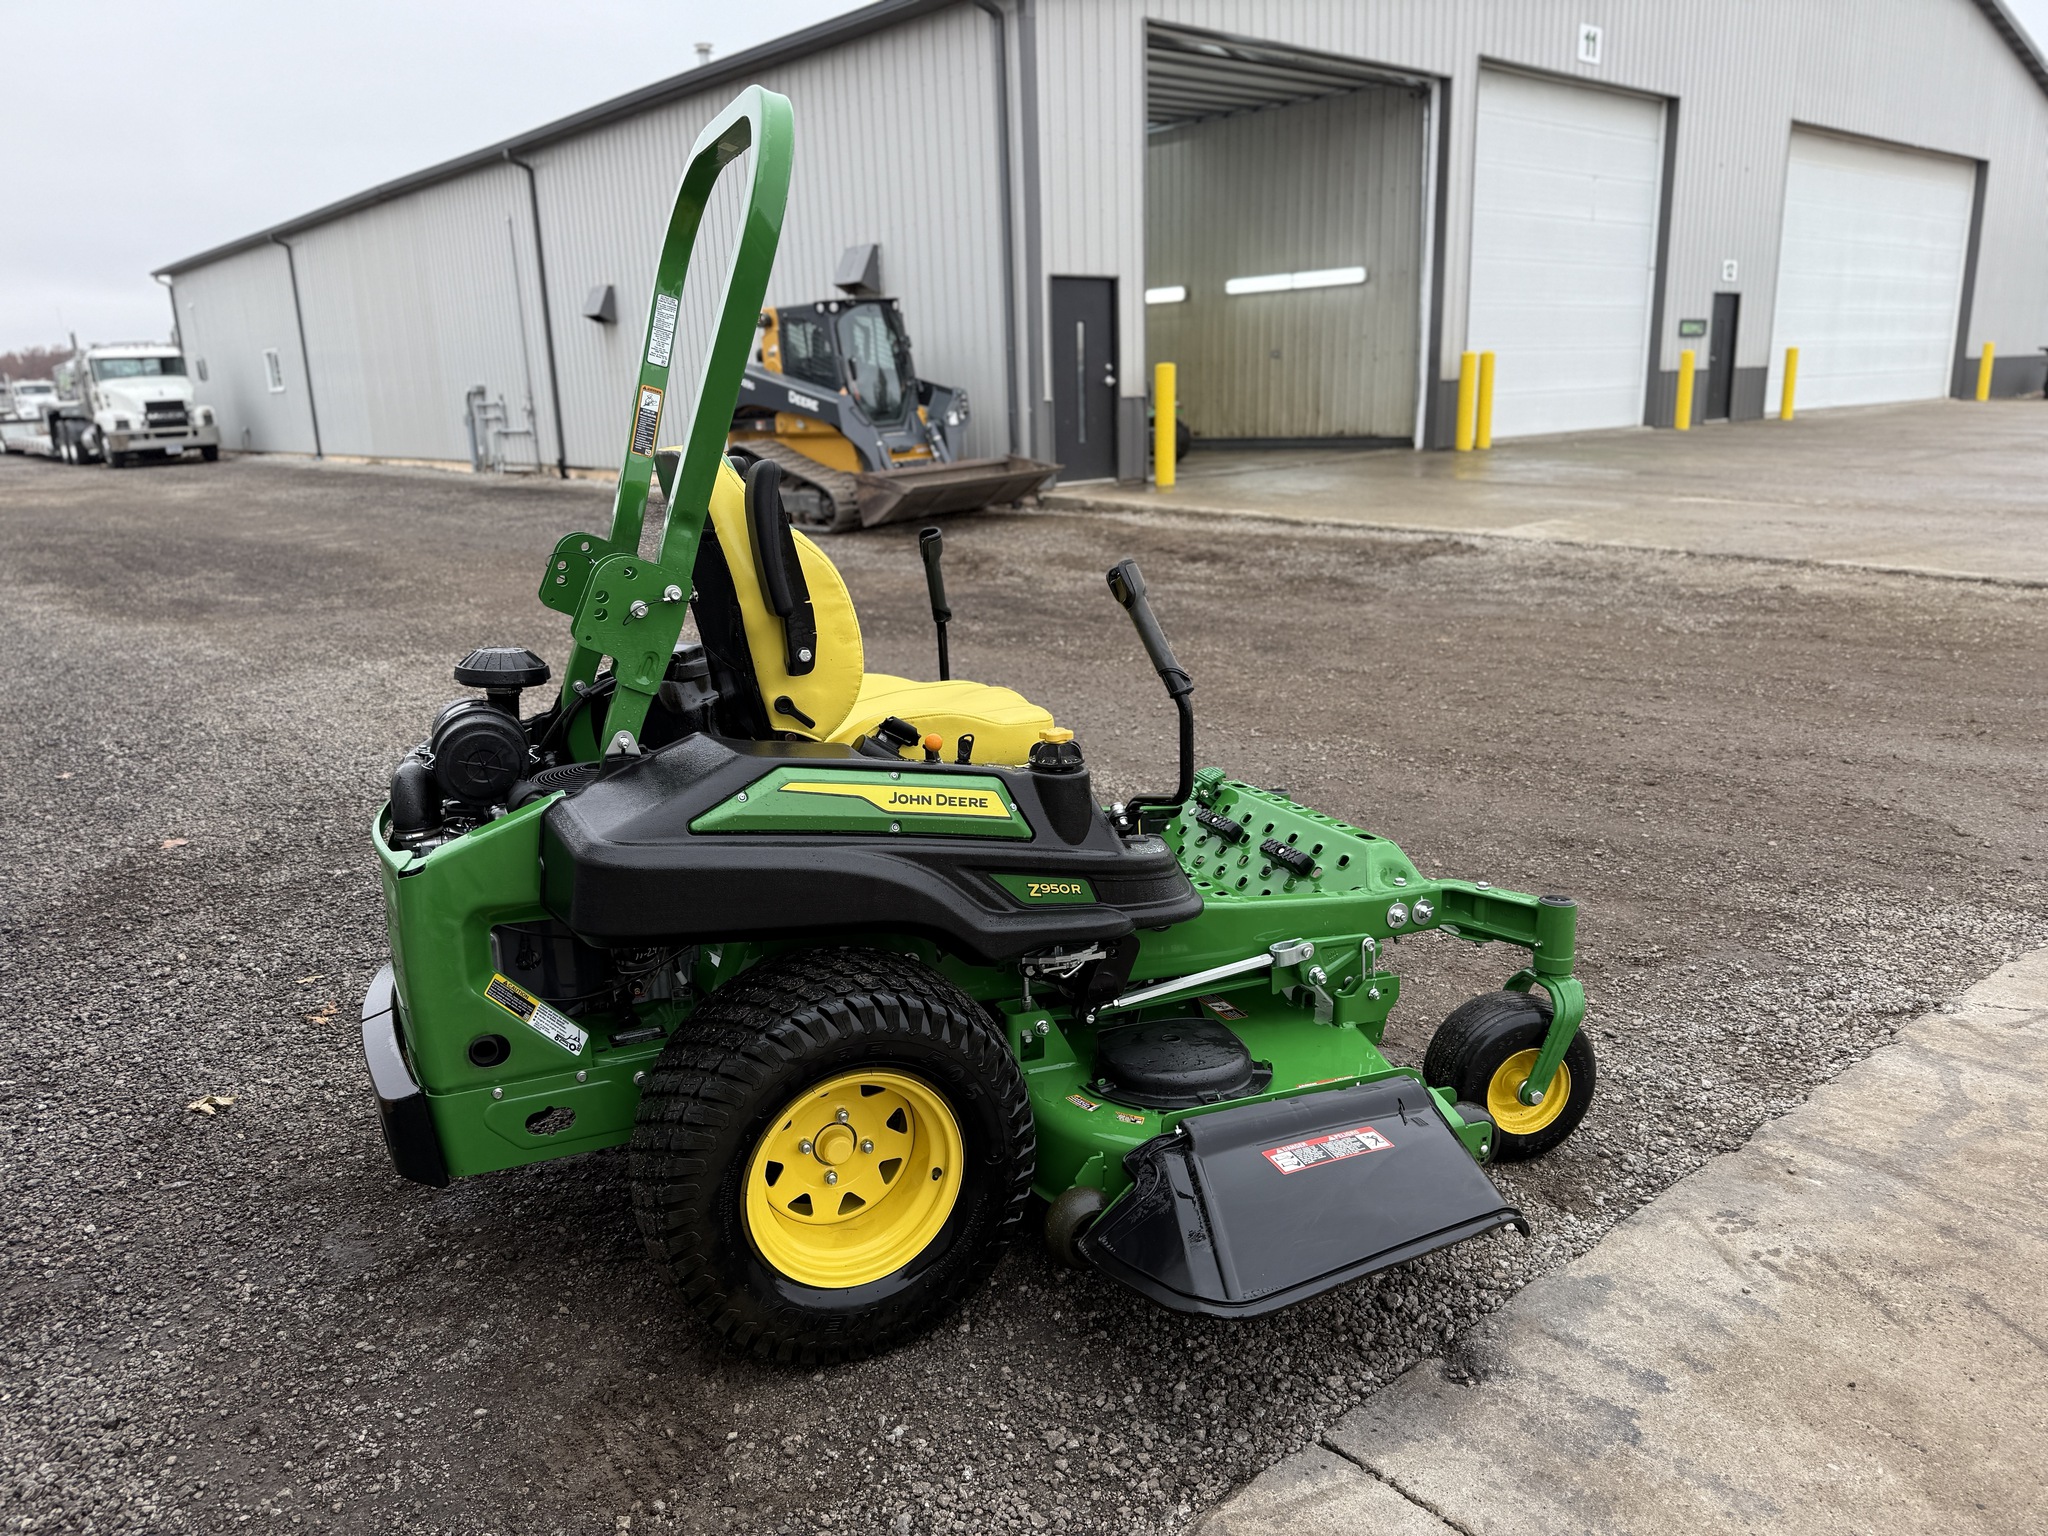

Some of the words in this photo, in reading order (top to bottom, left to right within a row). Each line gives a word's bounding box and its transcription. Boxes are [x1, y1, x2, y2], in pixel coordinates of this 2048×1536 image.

[888, 791, 932, 806] JOHN
[936, 793, 989, 809] DEERE
[1027, 882, 1082, 898] Z950R
[507, 982, 531, 1000] CAUTION
[1281, 1141, 1308, 1152] DANGER
